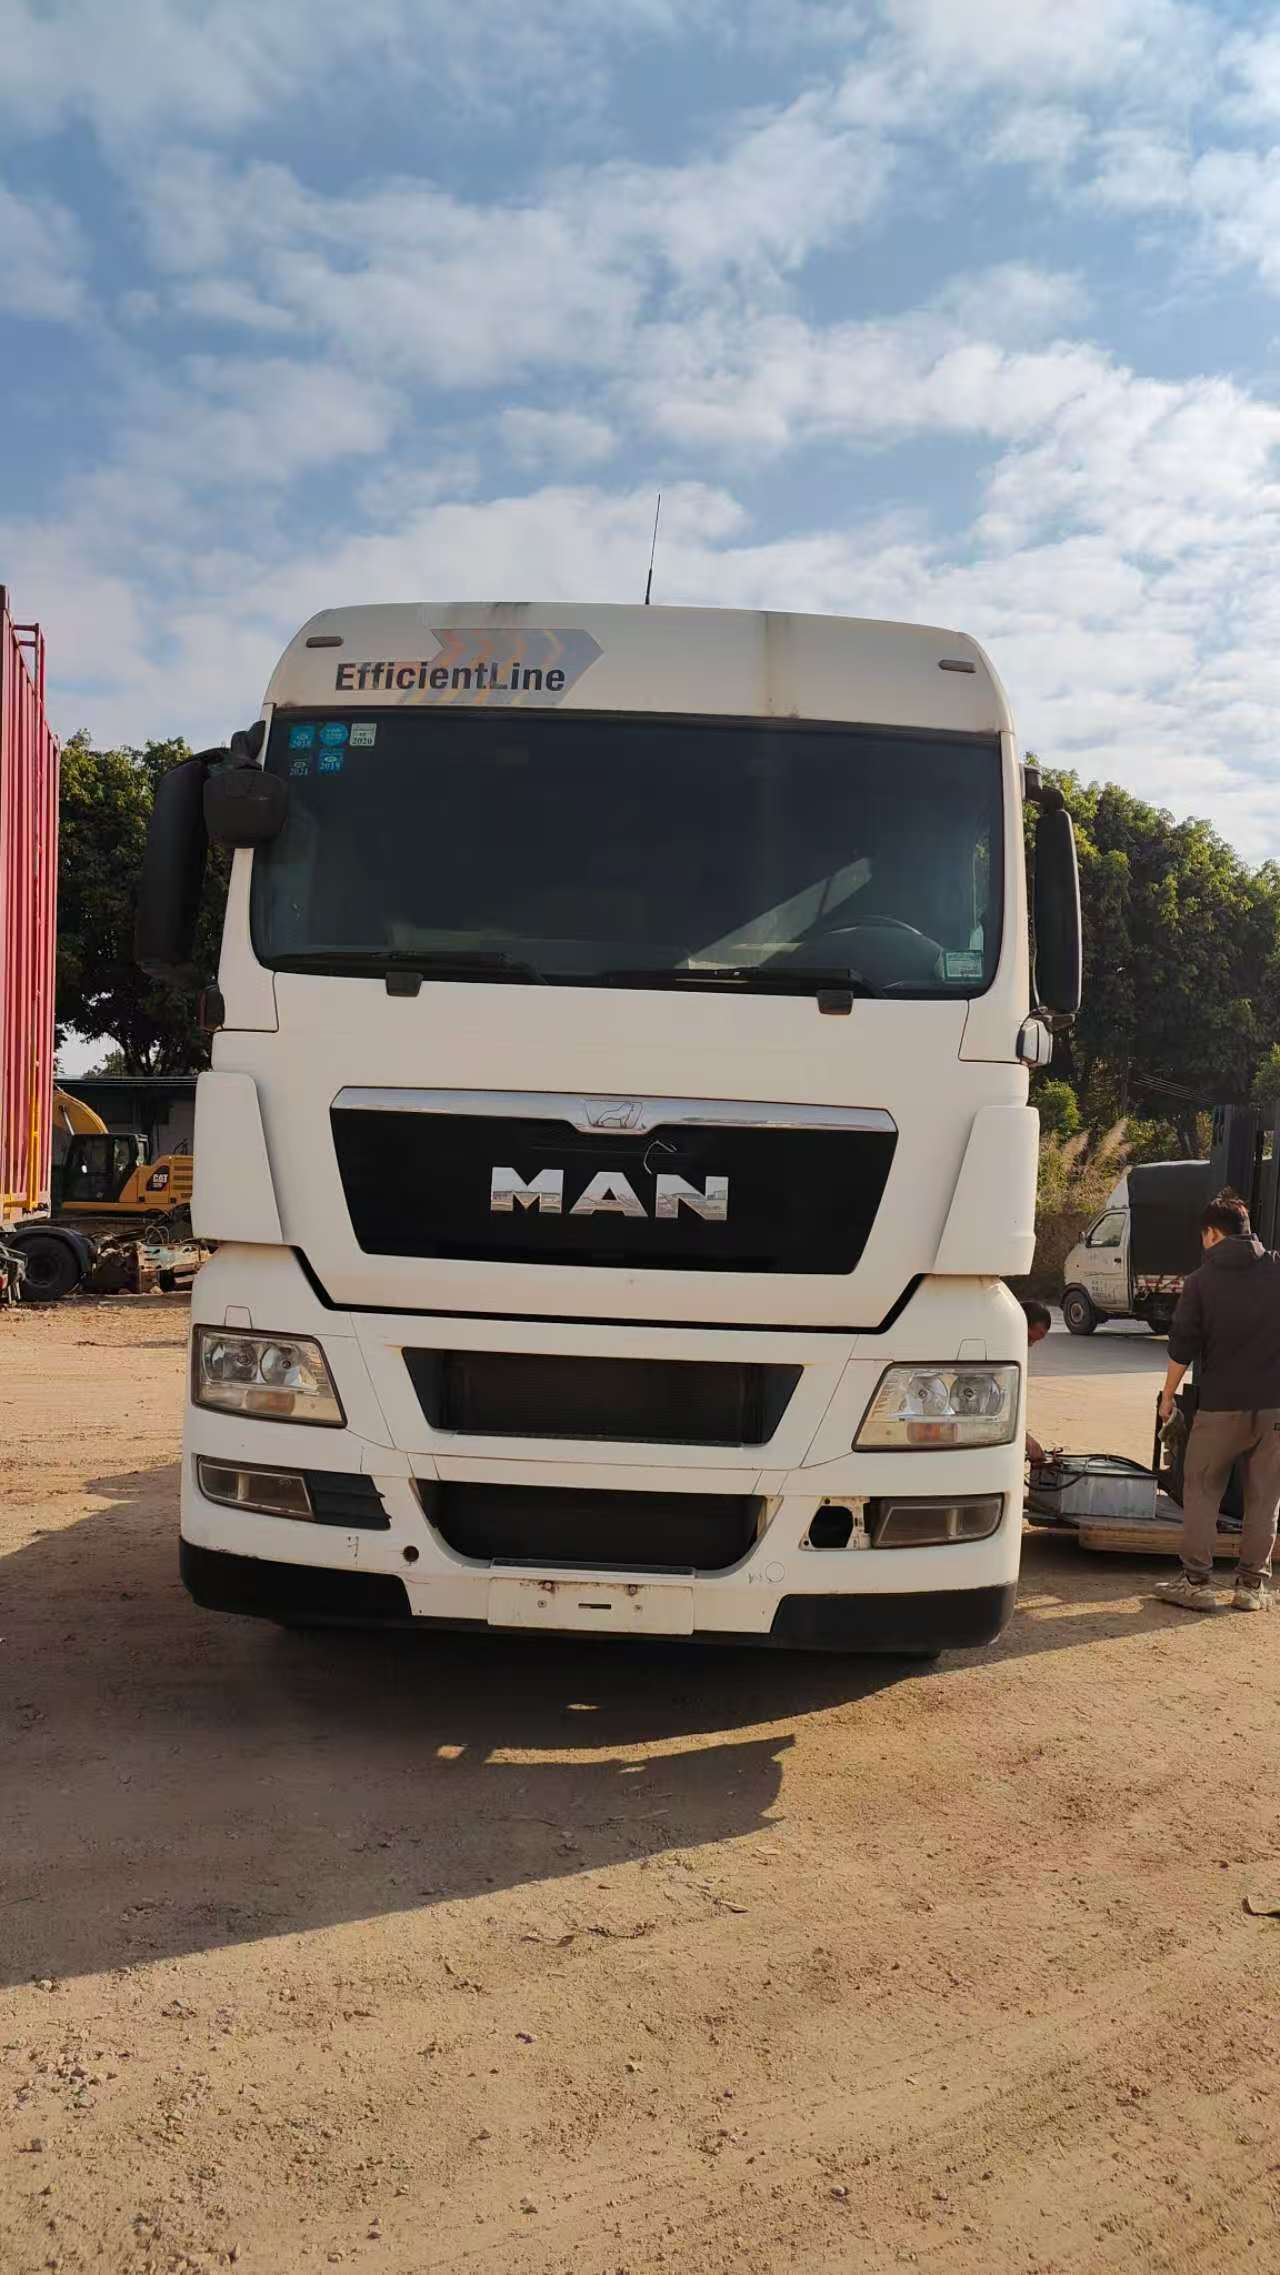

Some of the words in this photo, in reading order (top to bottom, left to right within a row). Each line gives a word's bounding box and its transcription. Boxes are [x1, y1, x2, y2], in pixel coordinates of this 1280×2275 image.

[336, 661, 565, 691] EfficientLine
[352, 737, 373, 745] 2020
[153, 1173, 169, 1183] CAT
[491, 1166, 729, 1220] MAN
